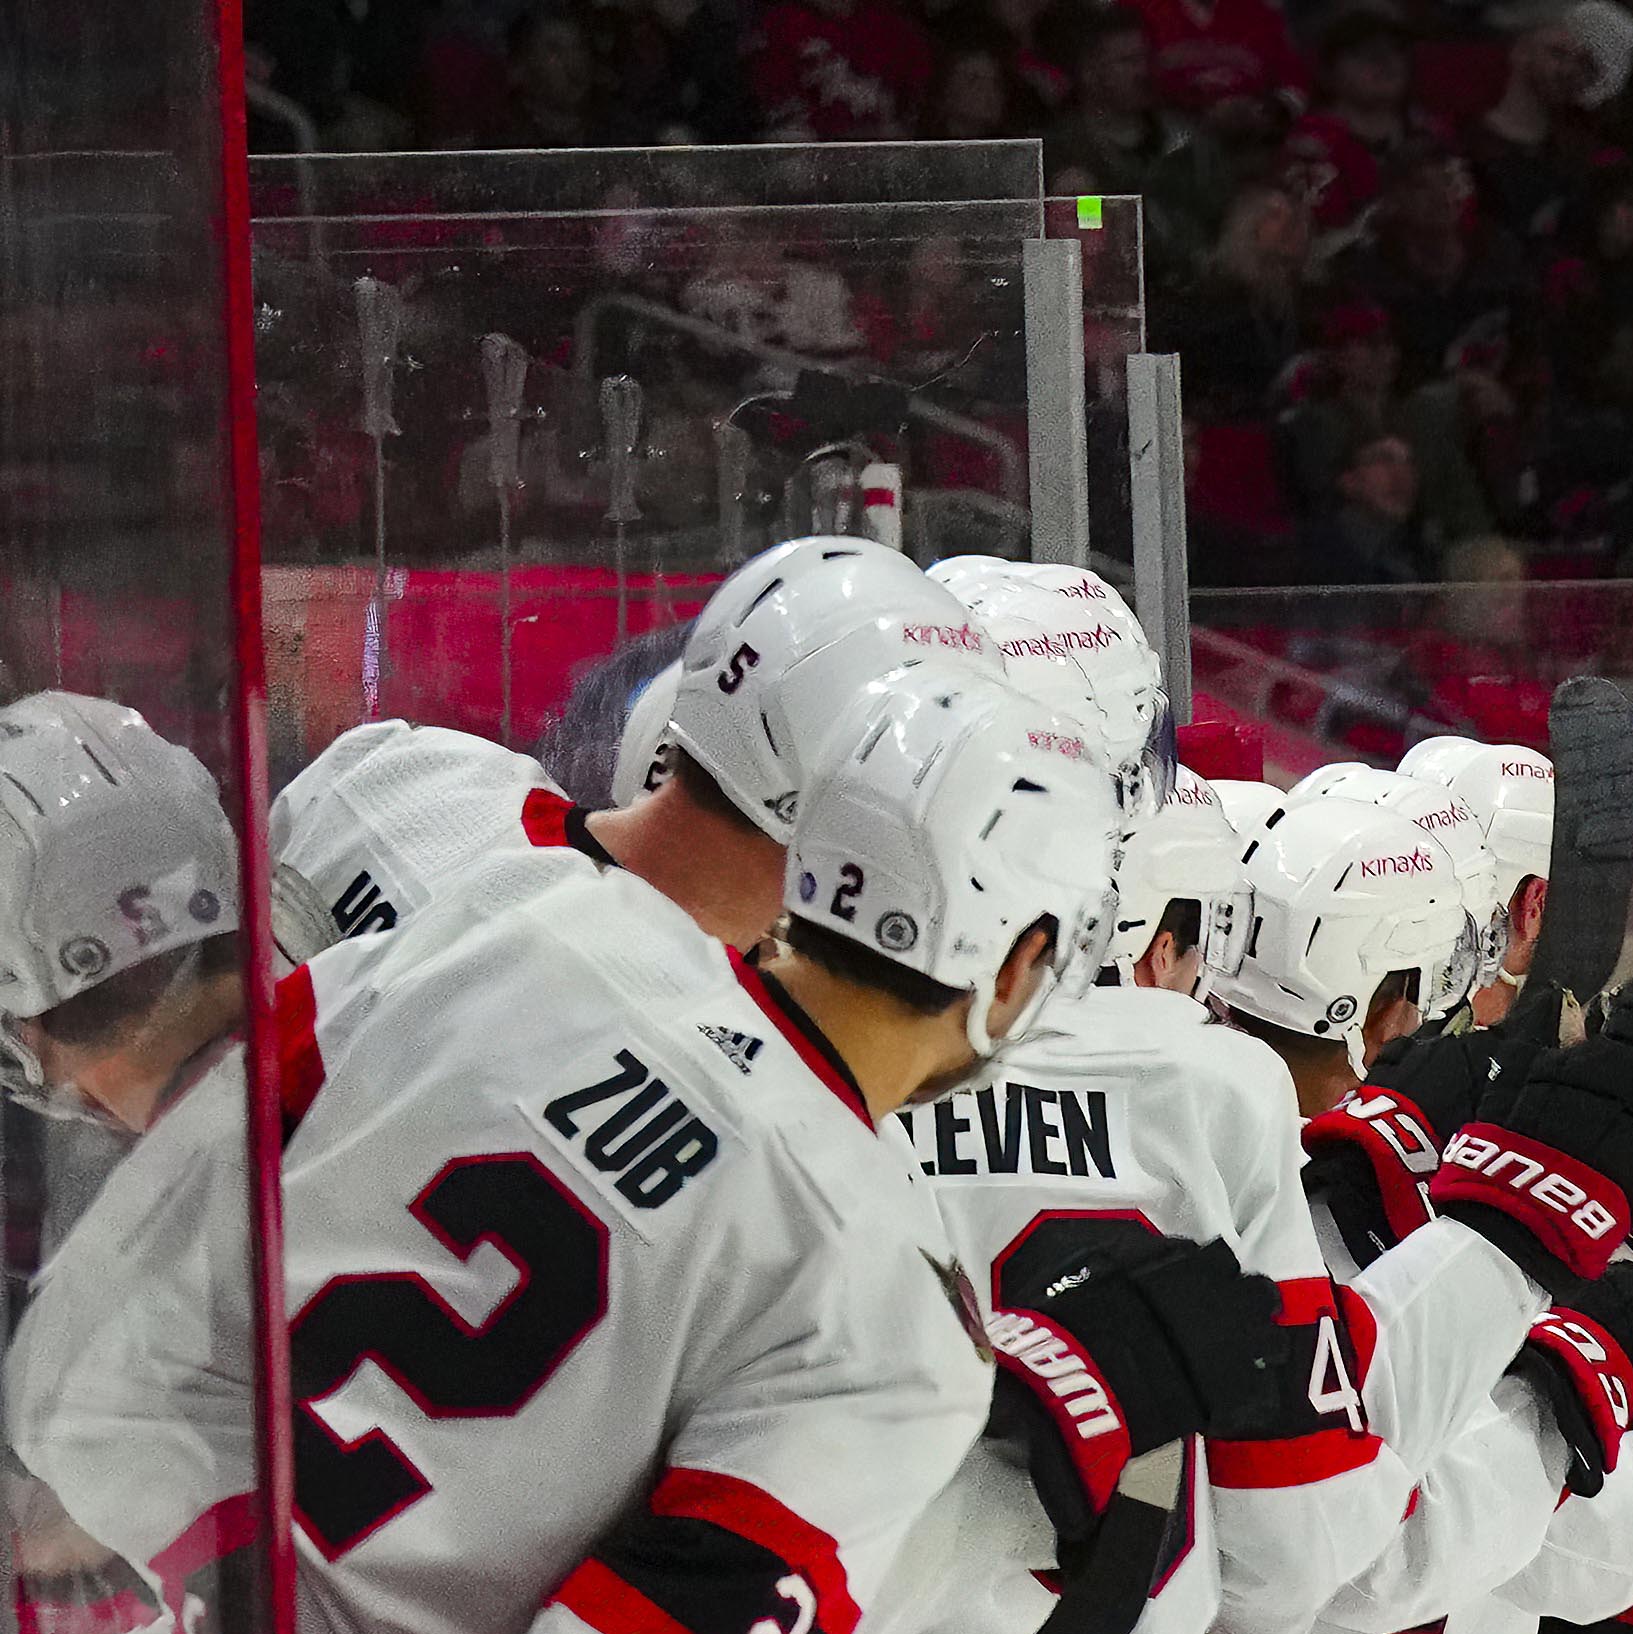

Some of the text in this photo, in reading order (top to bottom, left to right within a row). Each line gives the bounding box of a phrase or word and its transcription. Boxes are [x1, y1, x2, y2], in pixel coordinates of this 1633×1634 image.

[717, 642, 761, 695] 5
[829, 861, 864, 923] 2
[1359, 846, 1434, 880] kinaxis
[543, 1047, 720, 1210] ZUB
[289, 1151, 610, 1563] 2
[1307, 1314, 1366, 1433] 4
